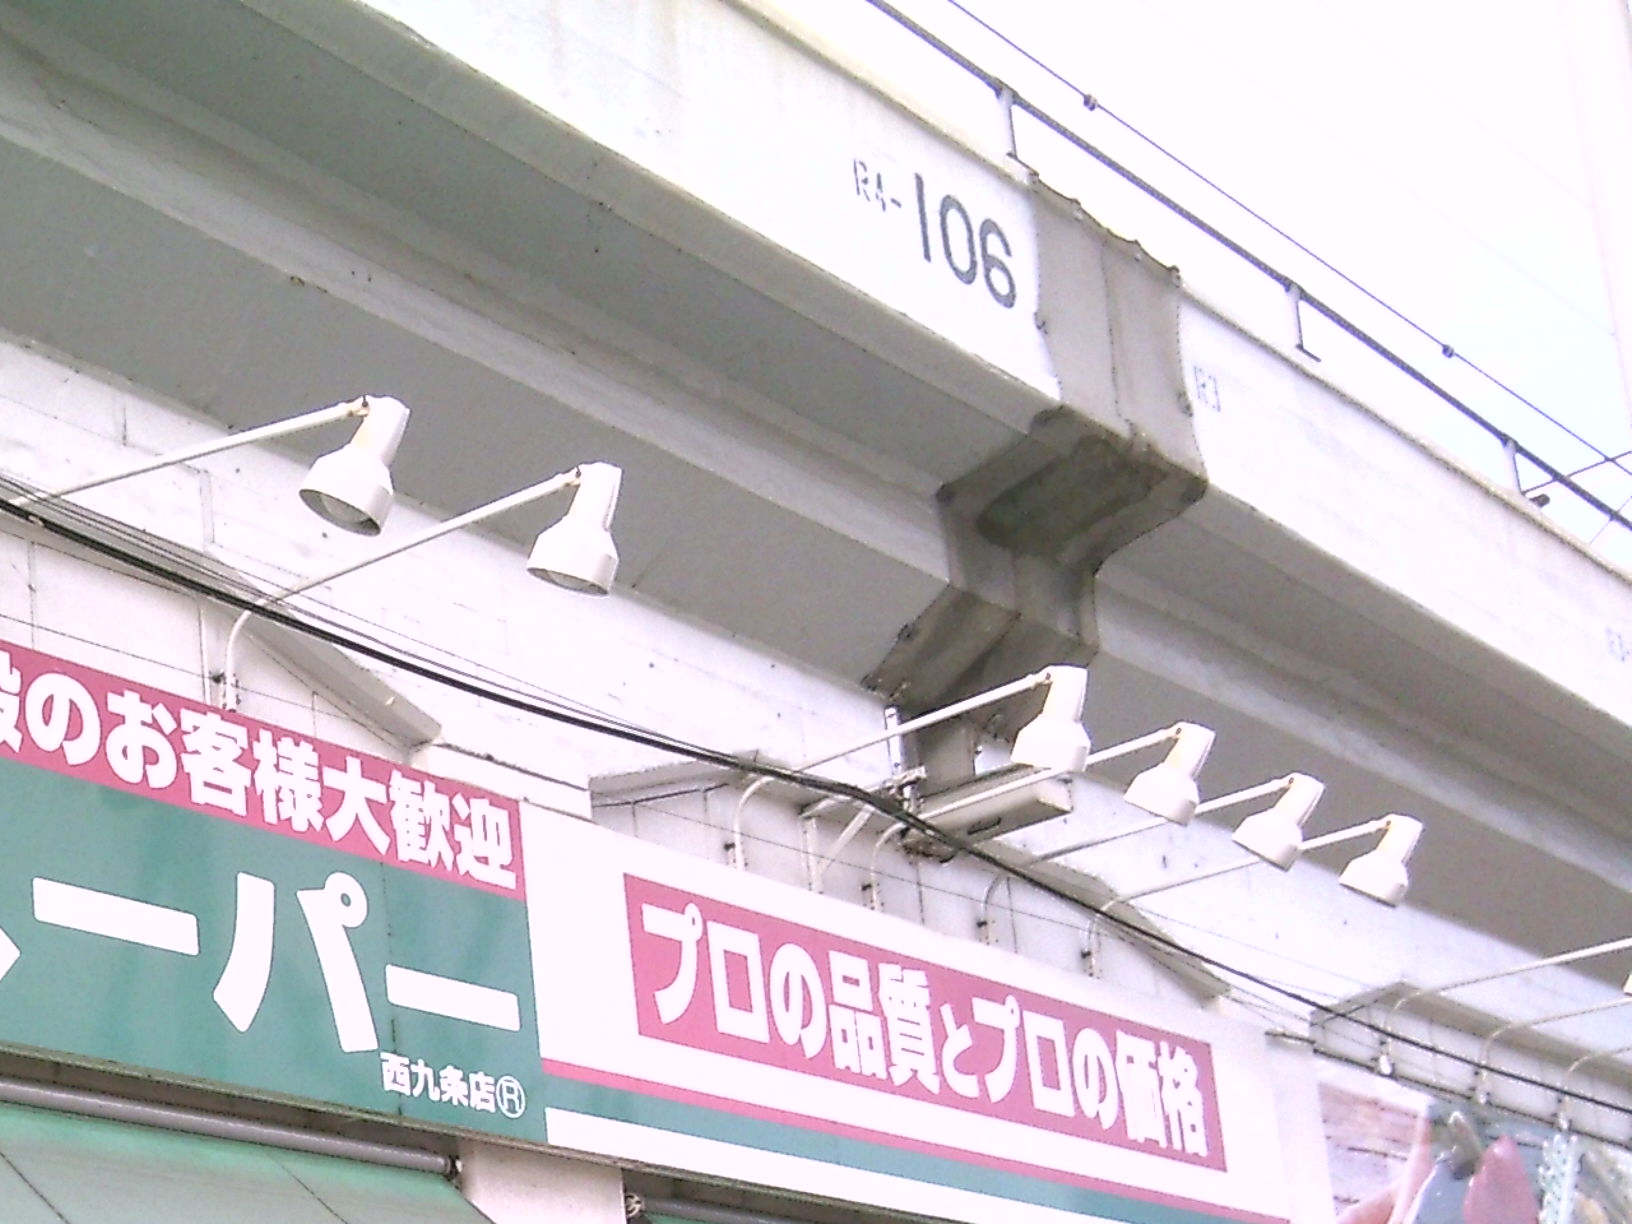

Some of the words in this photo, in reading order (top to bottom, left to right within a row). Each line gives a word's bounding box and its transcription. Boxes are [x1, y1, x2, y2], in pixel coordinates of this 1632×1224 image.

[641, 902, 1209, 1158] プロの品質とプロの価格
